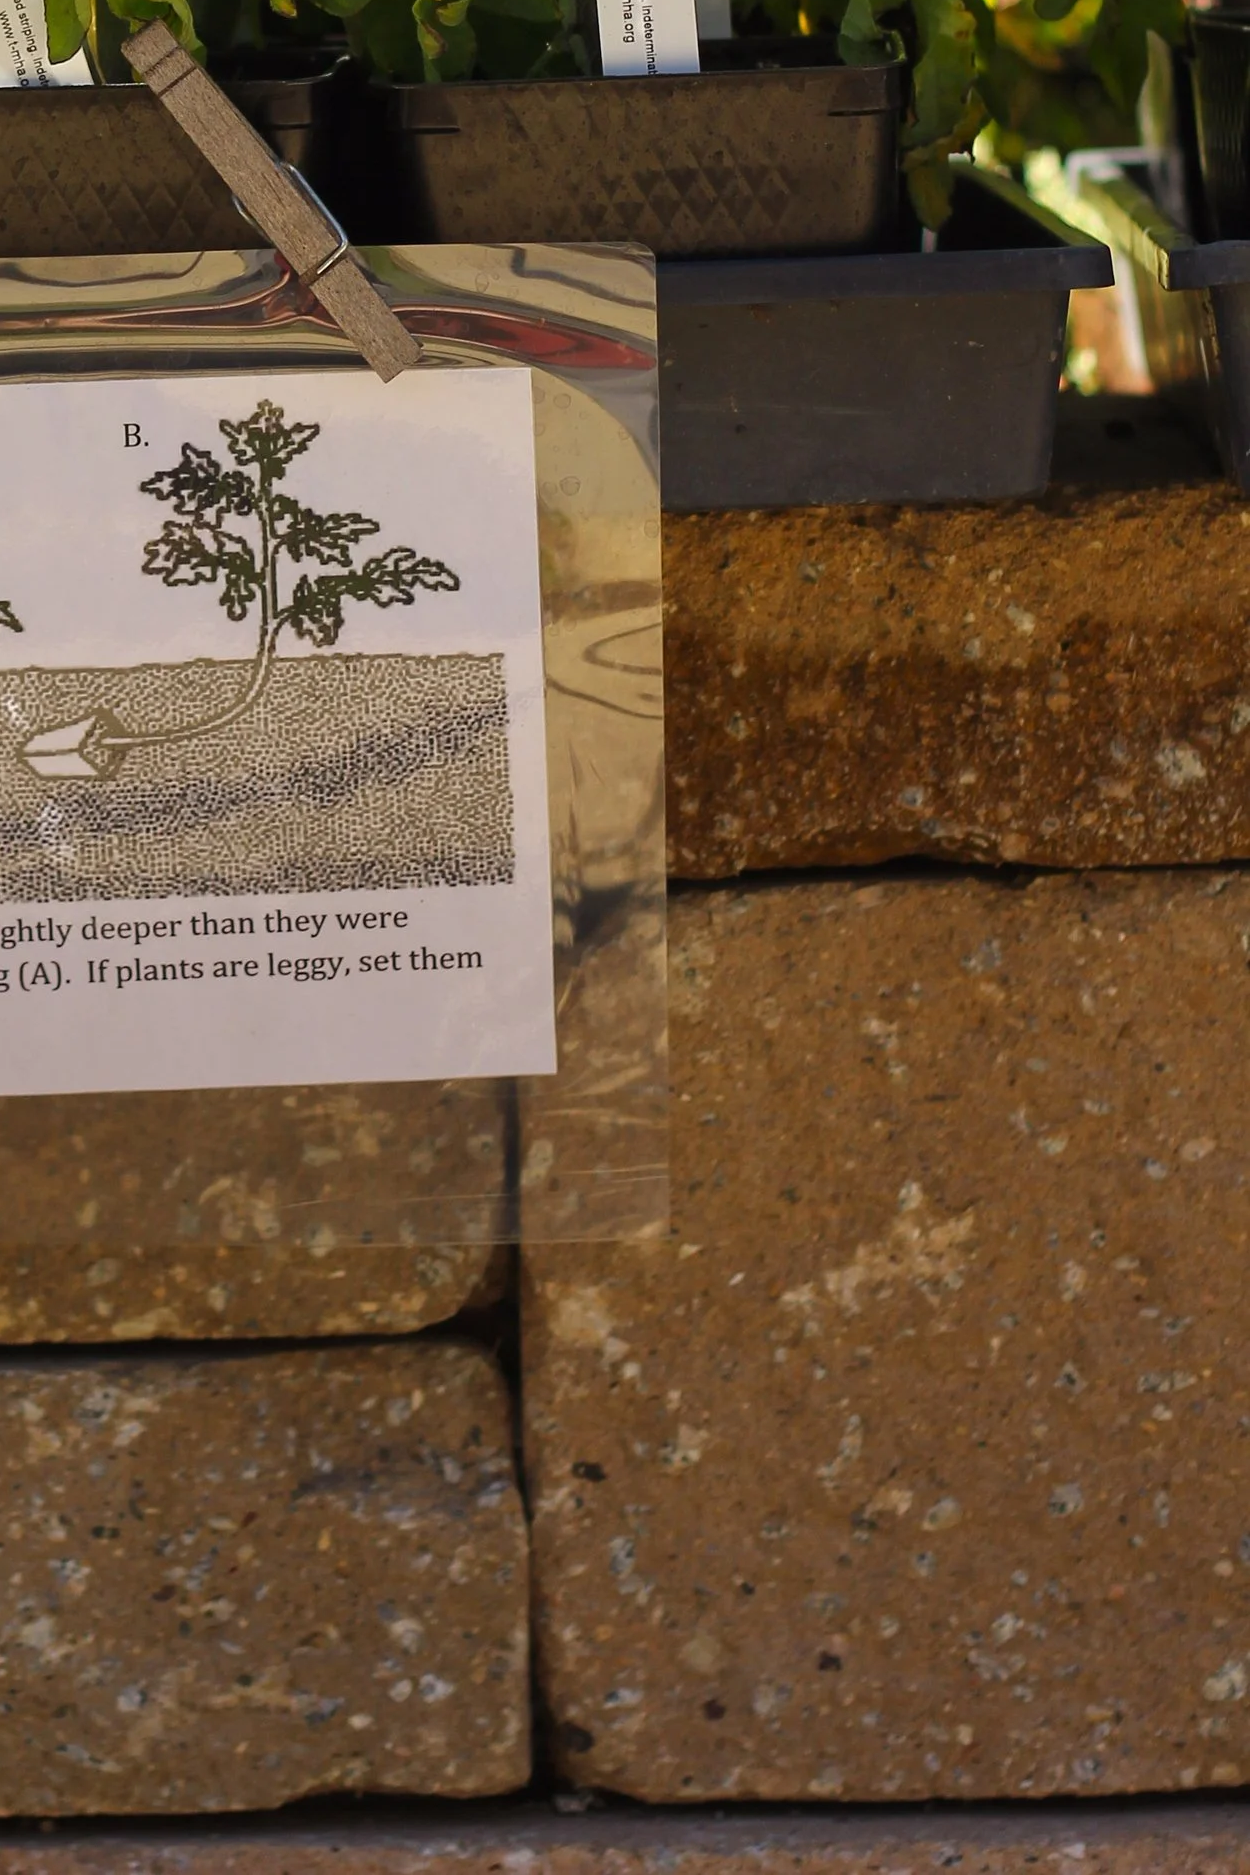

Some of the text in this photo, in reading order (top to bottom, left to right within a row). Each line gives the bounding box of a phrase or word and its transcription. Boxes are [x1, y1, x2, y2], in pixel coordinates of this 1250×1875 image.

[18, 12, 37, 56] striping.
[642, 6, 659, 75] Indeterminat
[123, 423, 149, 447] B.
[81, 915, 182, 945] deeper
[190, 912, 255, 936] than
[264, 909, 327, 938] they
[335, 910, 409, 930] were
[19, 961, 71, 992] (A).
[87, 959, 110, 983] If
[115, 958, 204, 989] plants
[212, 959, 259, 978] are
[268, 952, 351, 982] leggy,
[358, 950, 401, 973] set
[409, 946, 483, 971] them
